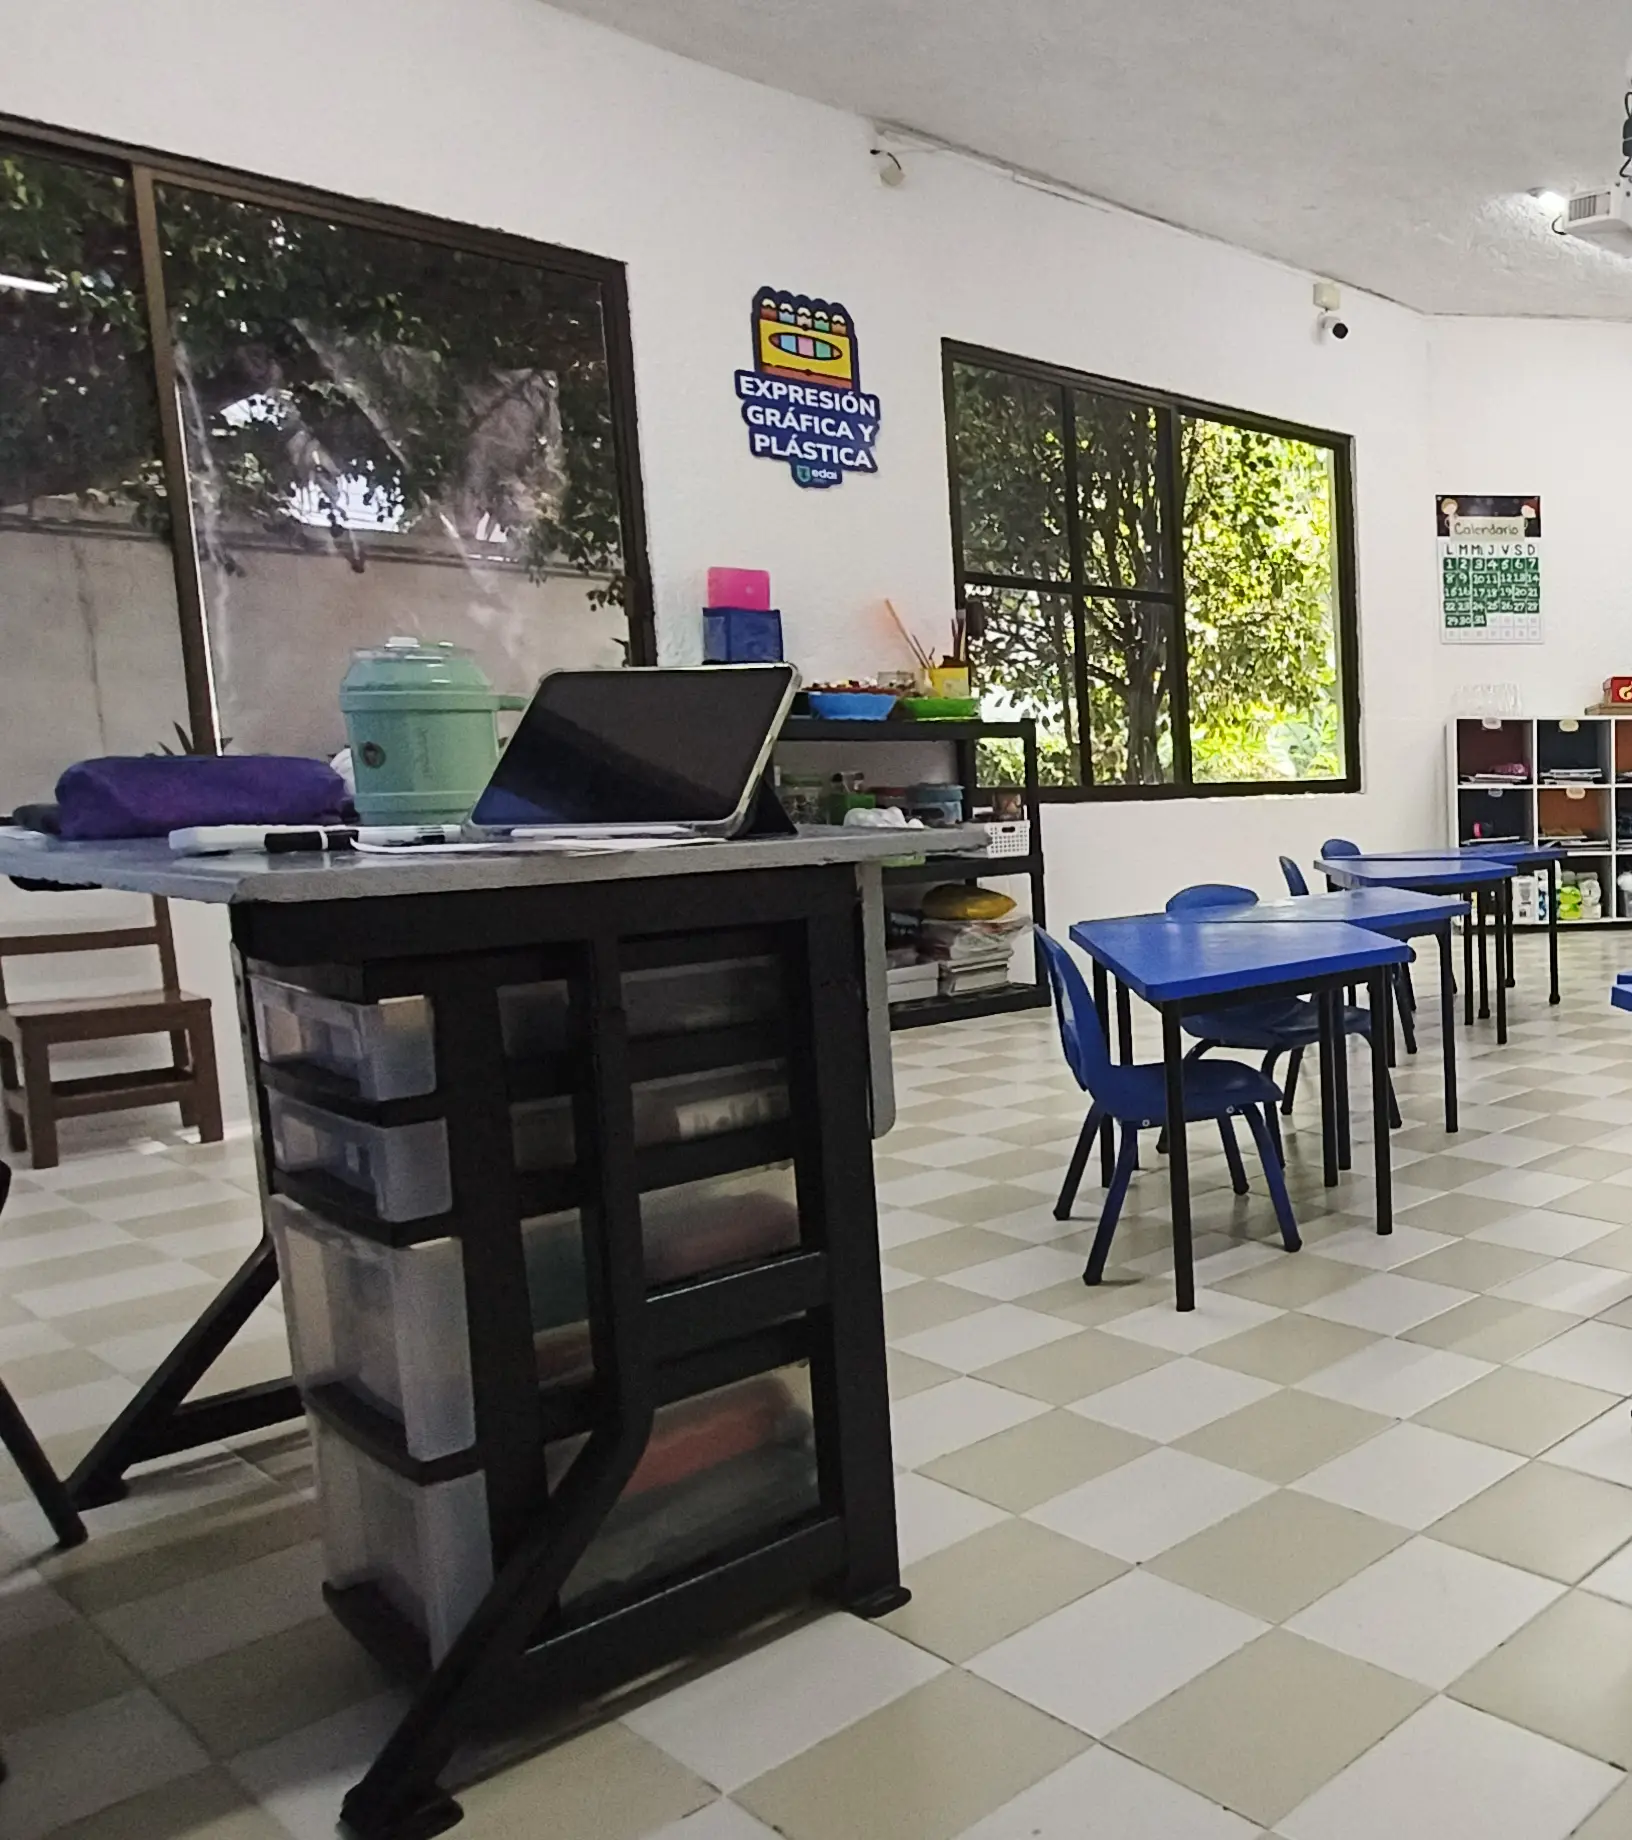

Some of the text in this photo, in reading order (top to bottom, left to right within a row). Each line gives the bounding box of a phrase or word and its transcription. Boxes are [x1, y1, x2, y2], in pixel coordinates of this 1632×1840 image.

[740, 375, 875, 418] EXPRESIÓN
[746, 406, 874, 443] GRÁFICA Y
[754, 434, 872, 469] PLÁSTICA
[1454, 524, 1519, 535] Calendario
[1446, 544, 1453, 555] L
[1459, 544, 1468, 555] M
[1488, 545, 1494, 555] J
[1502, 544, 1509, 554] V
[1515, 544, 1522, 555] S
[1528, 544, 1535, 555] D
[1447, 559, 1536, 569] 1 2 3 4 5 6 7
[1459, 573, 1466, 583] 9
[1474, 575, 1484, 584] 10
[1486, 575, 1497, 584] 11
[1502, 573, 1512, 582] 12
[1528, 573, 1539, 583] 14
[1474, 588, 1485, 598] 17
[1501, 588, 1511, 596] 19
[1515, 588, 1527, 596] 20
[1528, 588, 1538, 597] 21
[1487, 602, 1498, 610] 25
[1501, 602, 1512, 610] 26
[1514, 602, 1525, 611] 27
